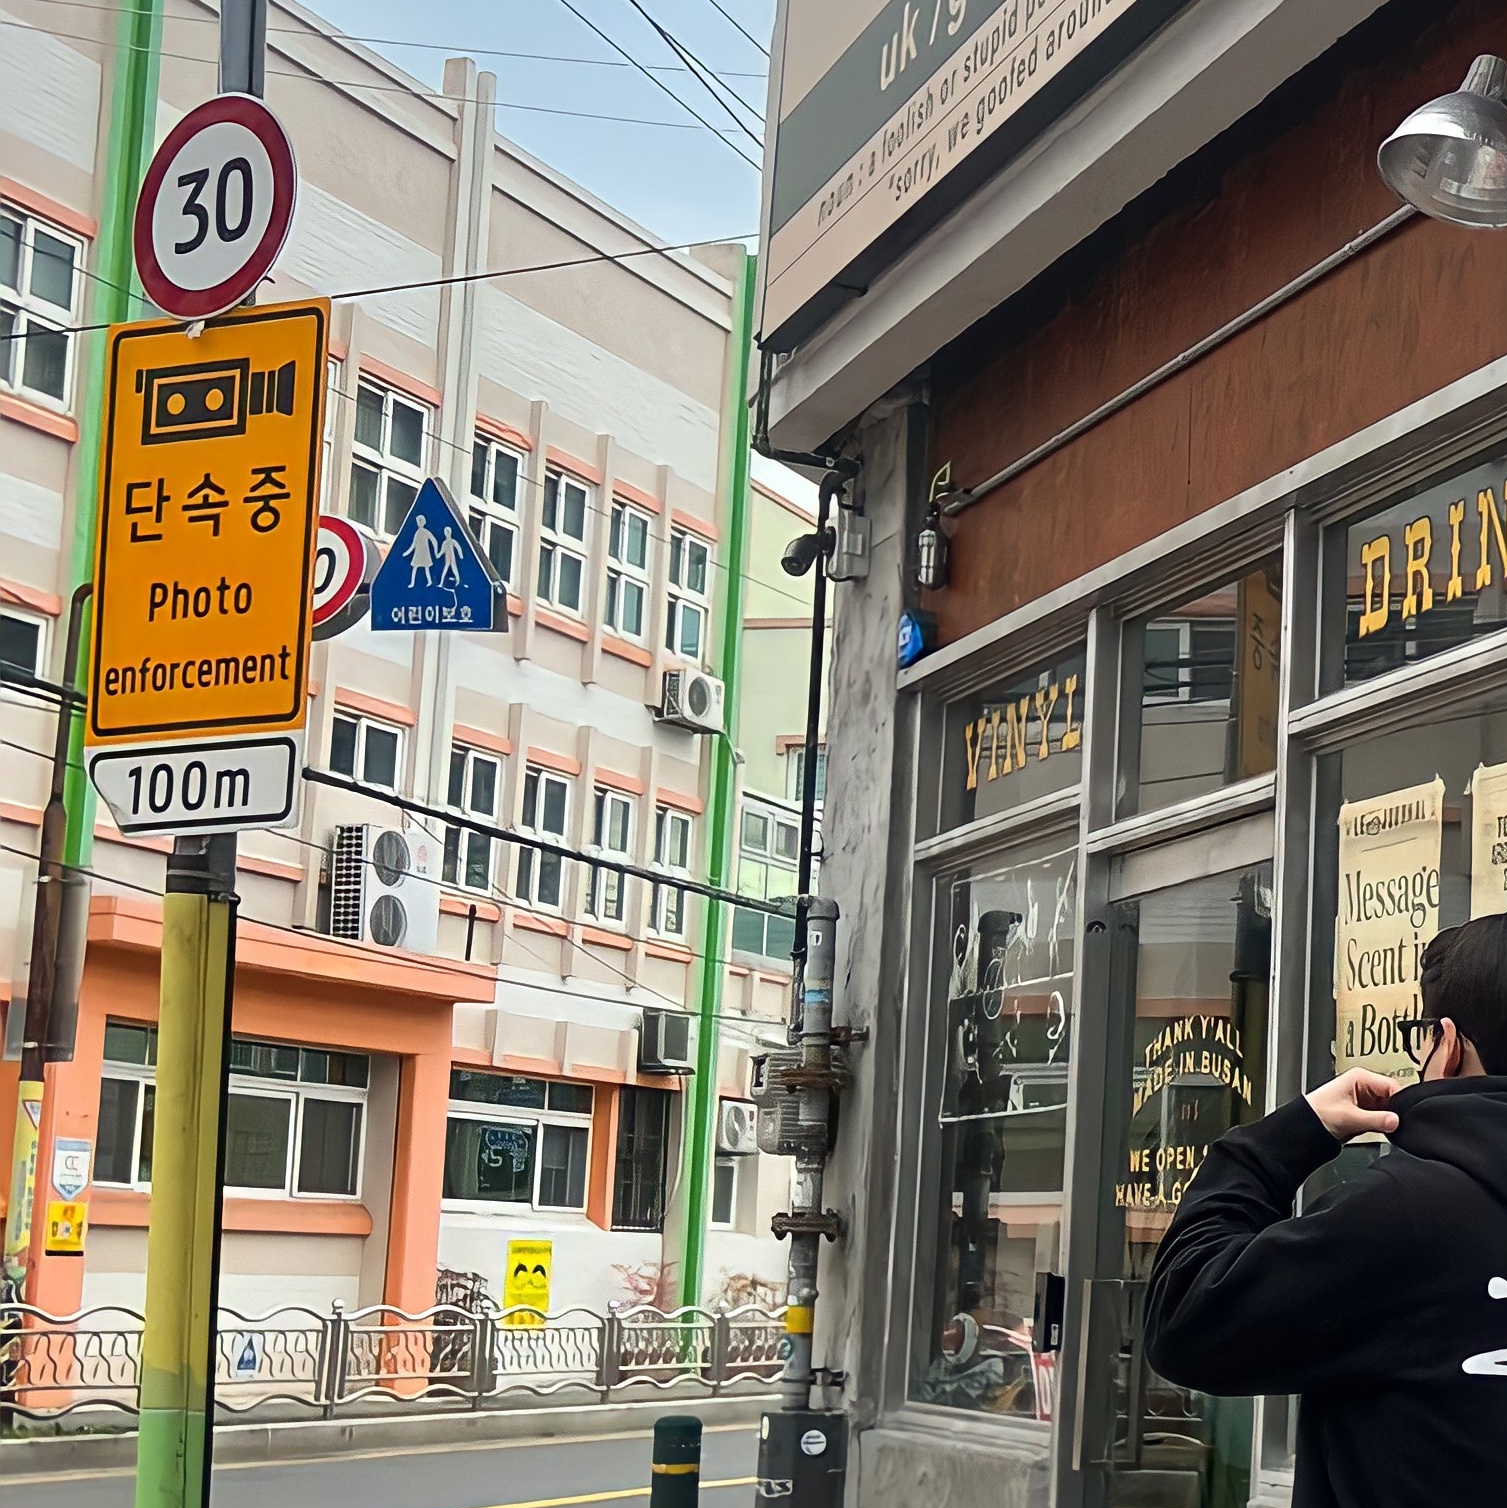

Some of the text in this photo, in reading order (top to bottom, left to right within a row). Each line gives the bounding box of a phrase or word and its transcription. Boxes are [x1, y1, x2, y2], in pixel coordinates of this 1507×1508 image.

[882, 86, 934, 164] foolish
[940, 70, 957, 105] or
[963, 0, 1018, 84] stupid
[948, 112, 970, 154] we
[976, 34, 1039, 135] goofed
[174, 157, 254, 256] 30
[125, 465, 291, 543] 단속중
[148, 576, 253, 622] Photo
[105, 645, 291, 696] enforcement
[965, 673, 1081, 791] VINYL
[128, 760, 251, 815] 100m
[1345, 866, 1440, 928] Message
[1347, 937, 1408, 991] Scent
[1145, 1014, 1244, 1067] THANK Y'ALL
[1346, 1020, 1355, 1058] a
[1179, 1050, 1195, 1077] IN
[1201, 1050, 1252, 1107] BUSAN
[1129, 1148, 1150, 1173] WE
[1156, 1145, 1195, 1172] OPEN
[1115, 1182, 1152, 1208] HAVE
